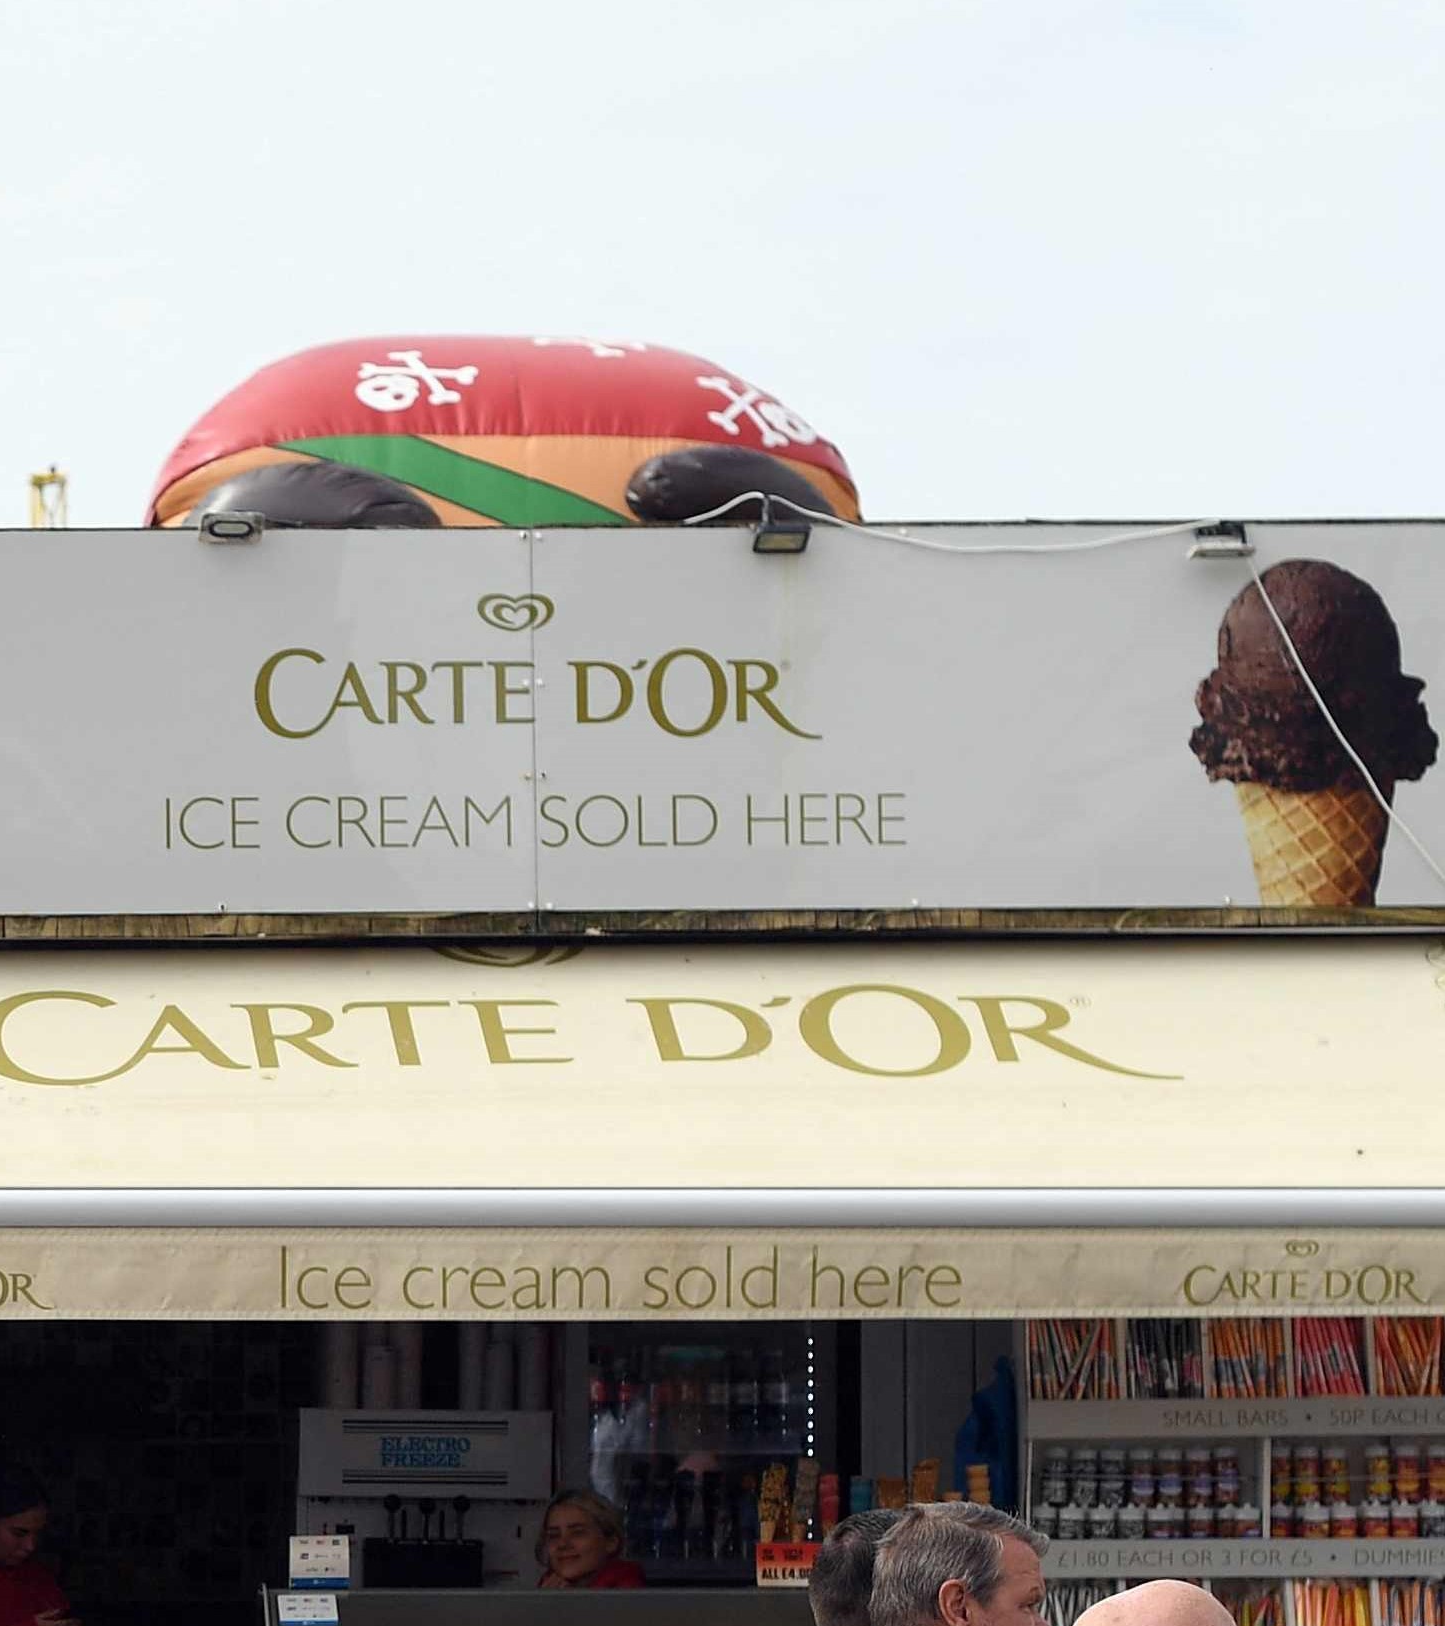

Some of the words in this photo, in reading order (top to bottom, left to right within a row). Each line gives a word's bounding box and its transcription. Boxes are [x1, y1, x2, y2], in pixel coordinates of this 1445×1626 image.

[254, 647, 536, 739] CARTE
[568, 647, 823, 740] D'OR
[165, 797, 261, 850] ICE
[285, 796, 512, 849] CREAM
[540, 794, 718, 848] SOLD
[747, 793, 908, 847] HERE
[626, 983, 1184, 1081] D'OR
[279, 1245, 372, 1310] Ice
[402, 1266, 612, 1311] cream
[643, 1245, 778, 1310] sold
[810, 1245, 963, 1309] here
[1183, 1264, 1310, 1307] CARTE
[1325, 1264, 1429, 1305] D'OR
[1163, 1410, 1229, 1428] SMALL
[1236, 1409, 1289, 1427] BARS
[1372, 1408, 1430, 1426] EACH
[381, 1436, 471, 1453] ELECTRO
[381, 1452, 461, 1467] FREEZE
[762, 1567, 779, 1579] ALL
[1057, 1549, 1110, 1568] £1.80
[1117, 1549, 1174, 1568] EACH
[1181, 1549, 1215, 1568] OR
[1221, 1549, 1232, 1567] 3
[1240, 1549, 1284, 1567] FOR
